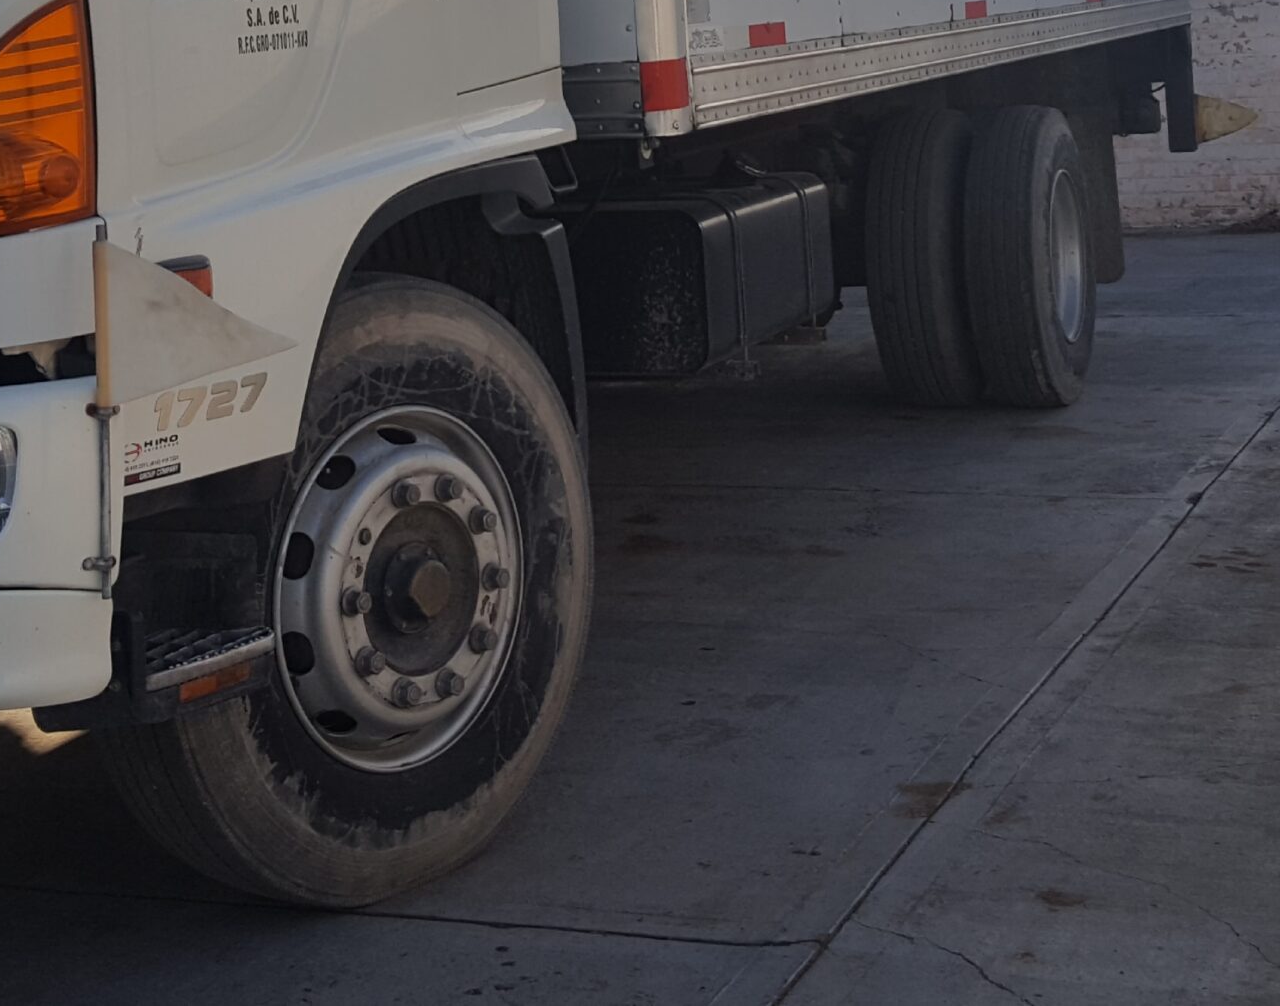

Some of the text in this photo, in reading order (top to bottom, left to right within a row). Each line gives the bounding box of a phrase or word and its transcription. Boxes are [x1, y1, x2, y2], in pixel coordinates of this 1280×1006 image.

[246, 4, 299, 27] S.A. de C.V.
[154, 372, 268, 432] 1727
[144, 434, 179, 448] HINO
